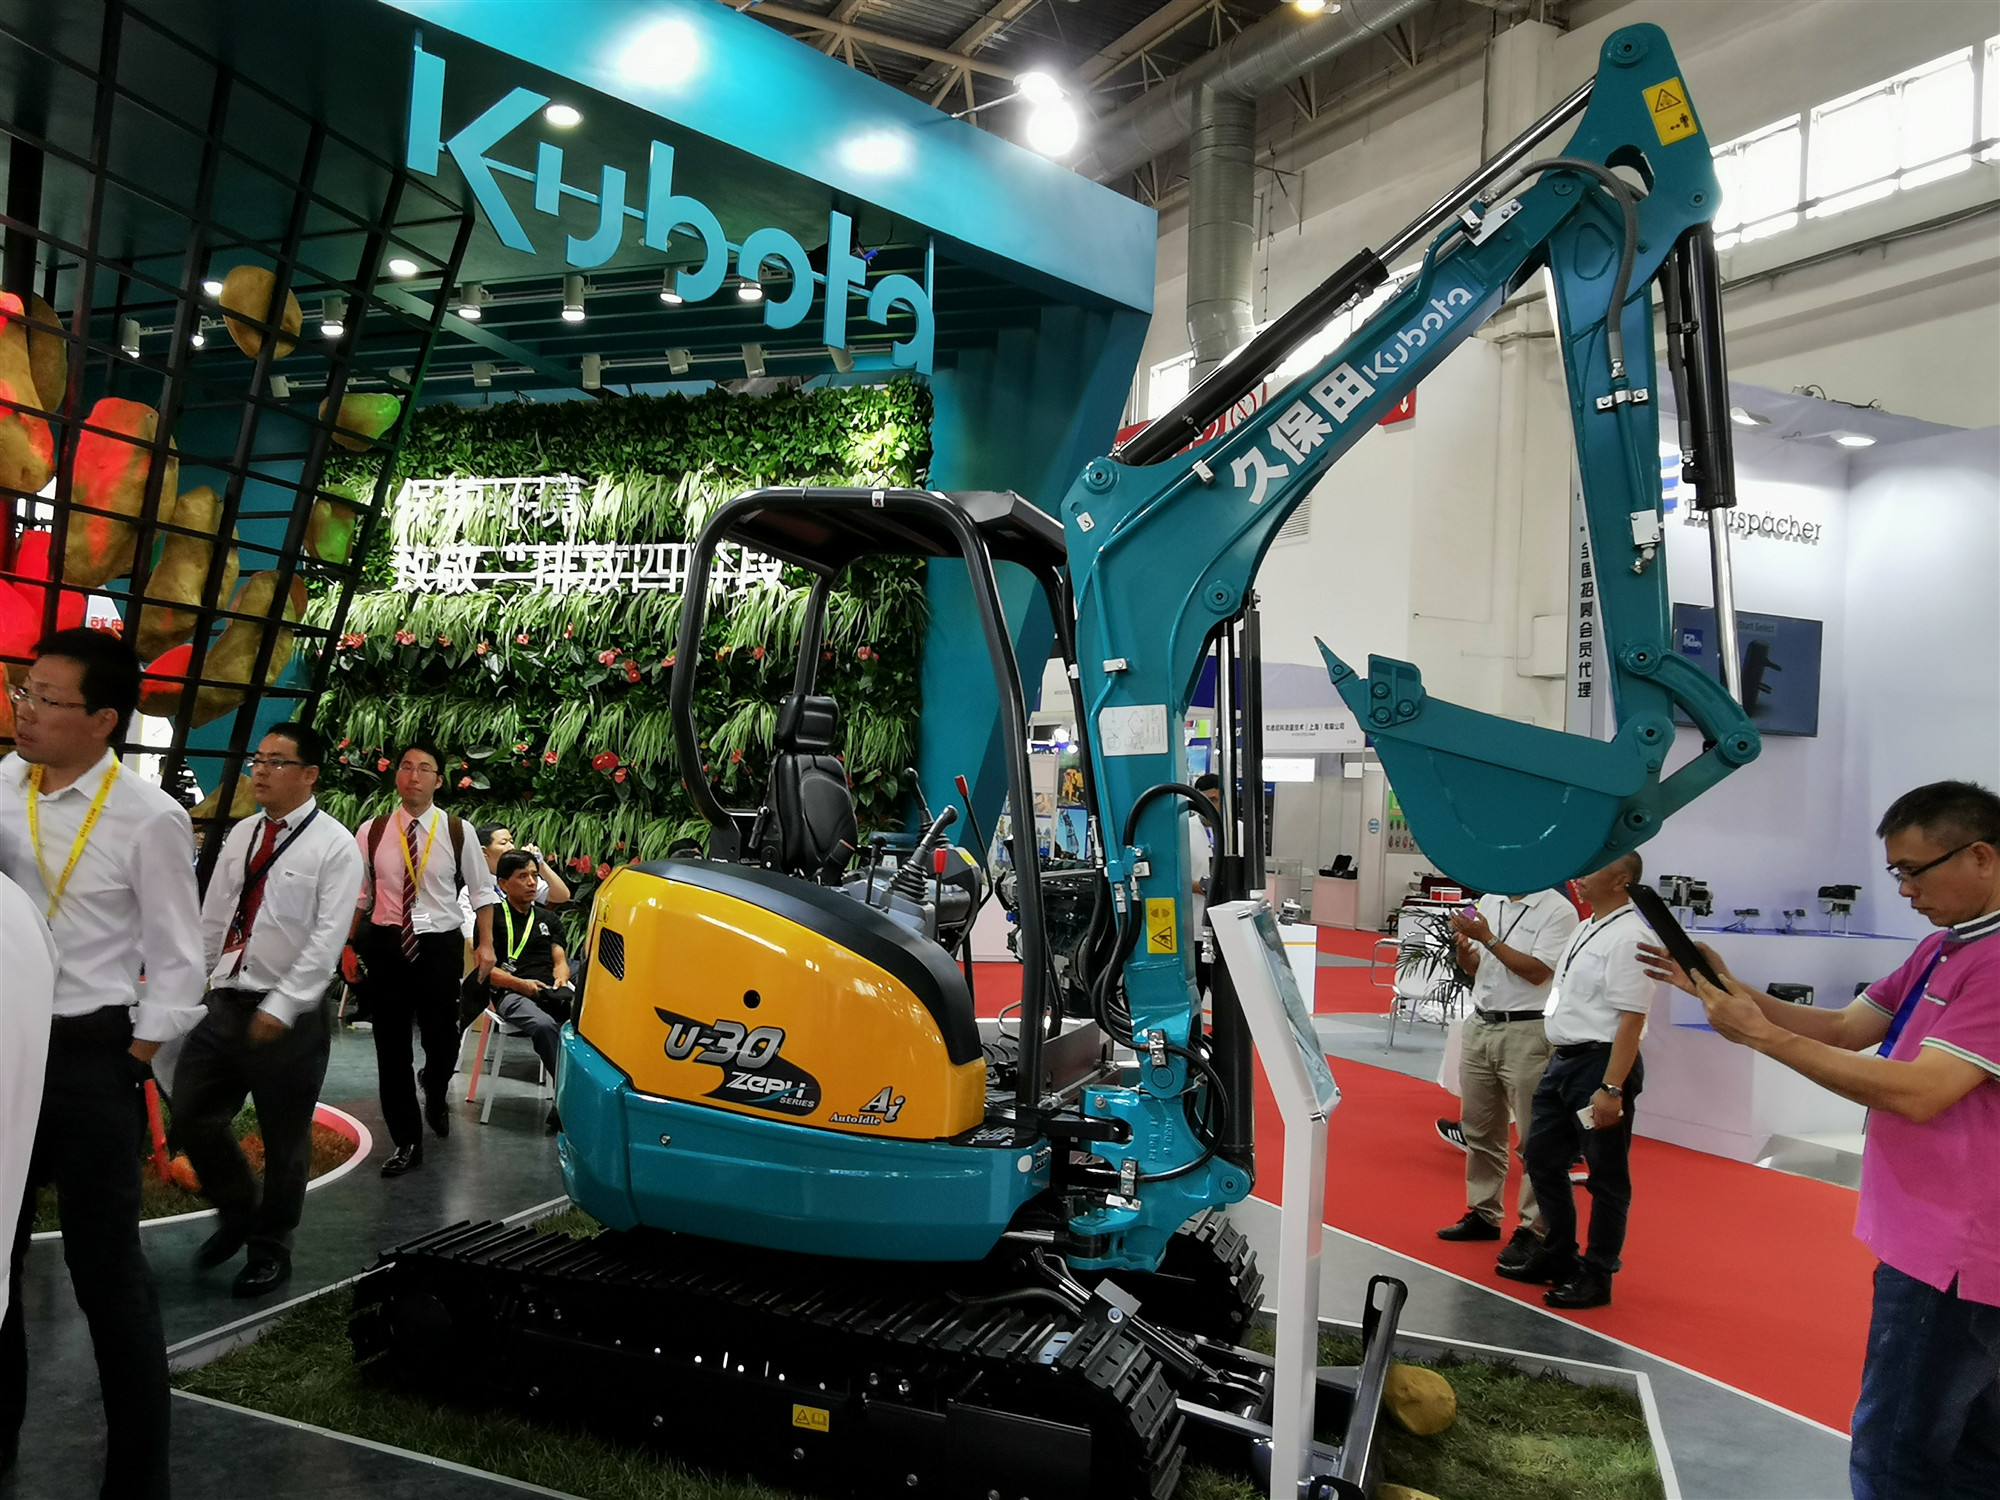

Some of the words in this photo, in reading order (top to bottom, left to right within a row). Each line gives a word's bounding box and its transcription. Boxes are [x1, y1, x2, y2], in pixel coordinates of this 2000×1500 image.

[406, 46, 935, 377] Kubota
[1361, 287, 1473, 381] Kubota
[1229, 362, 1376, 505] 久保田
[1686, 499, 1822, 540] Erspächer
[665, 1020, 784, 1068] U-30
[779, 1096, 815, 1108] SERIES
